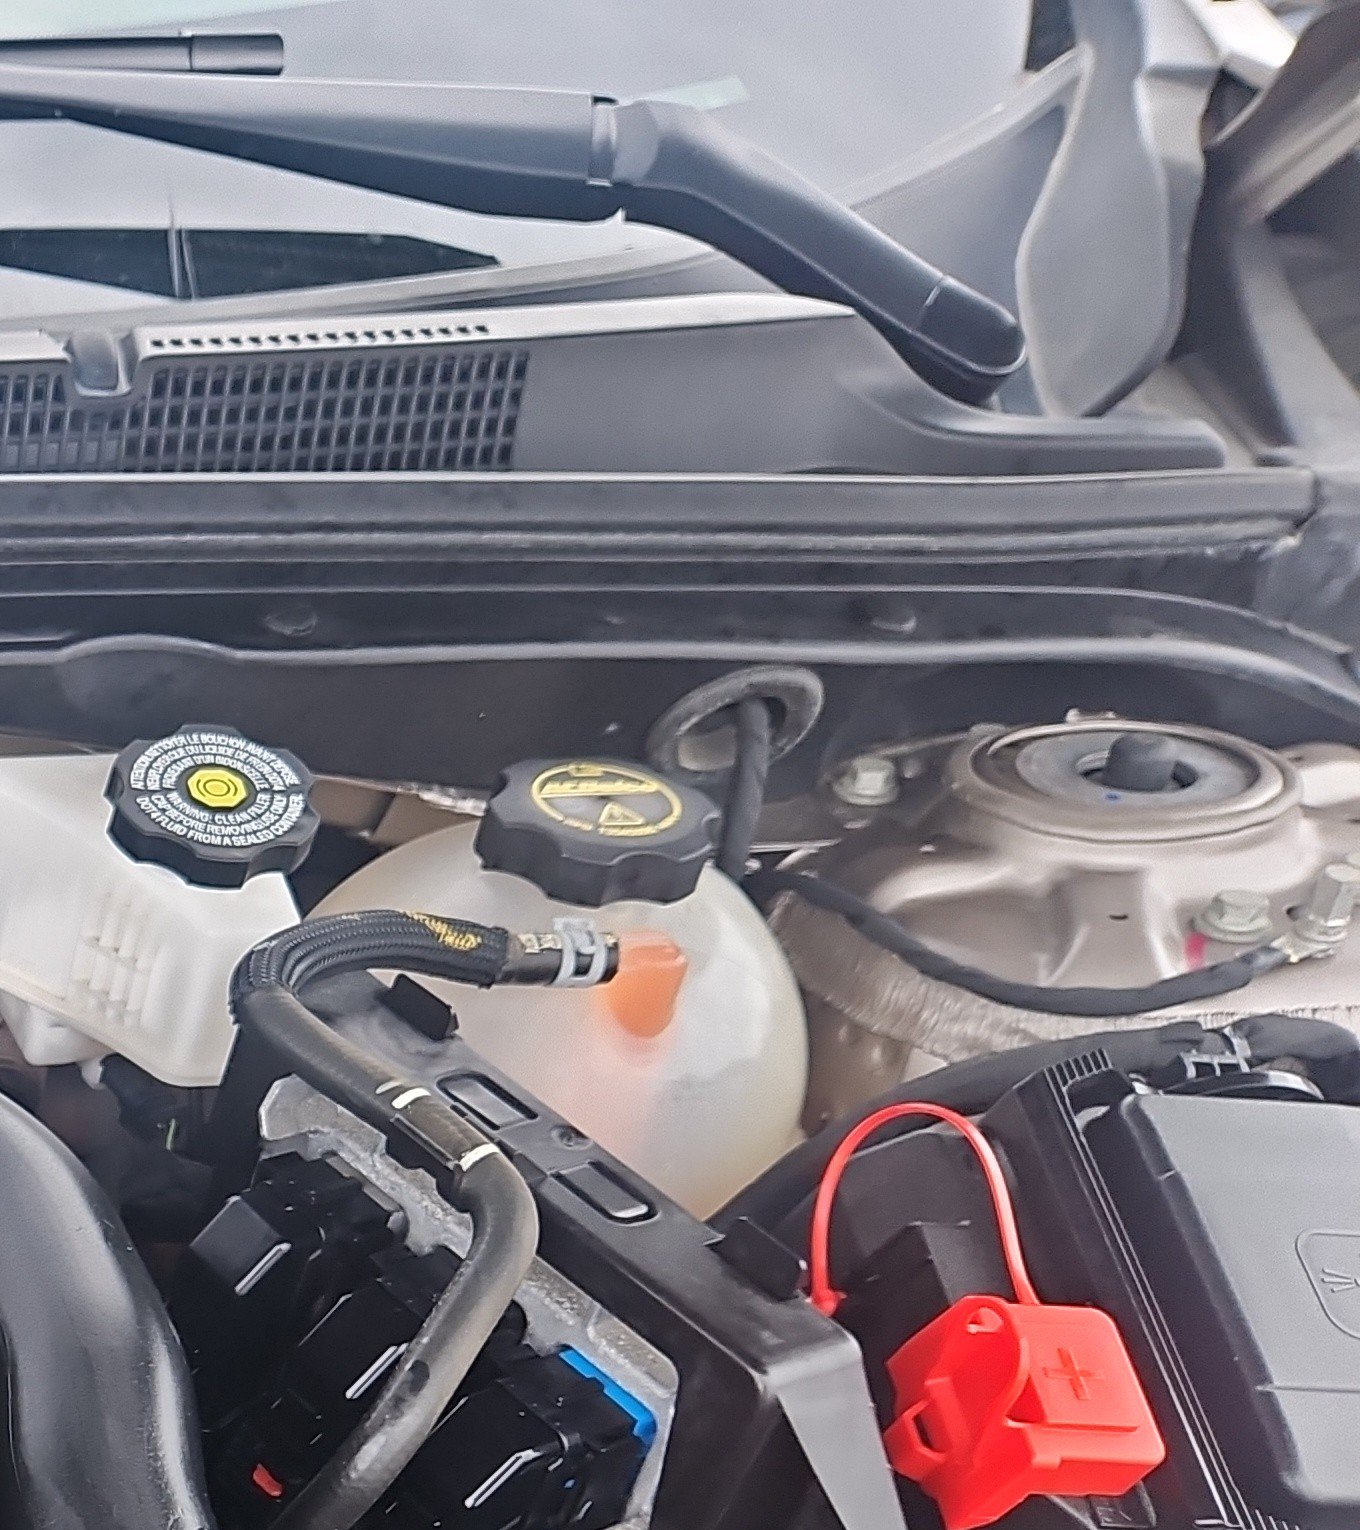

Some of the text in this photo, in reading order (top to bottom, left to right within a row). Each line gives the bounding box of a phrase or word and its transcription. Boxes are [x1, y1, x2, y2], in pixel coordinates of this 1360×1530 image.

[186, 733, 199, 744] LE
[200, 732, 246, 749] BOUCHON
[199, 744, 235, 756] LIQUIDE
[151, 794, 172, 811] CAP
[165, 808, 207, 832] BEFORE
[270, 793, 287, 815] ONLY
[214, 811, 253, 825] CLEAN
[247, 792, 271, 817] FILLER
[155, 815, 188, 836] FLUID
[186, 828, 222, 845] FROM
[222, 836, 232, 847] A
[232, 829, 275, 847] SEALED
